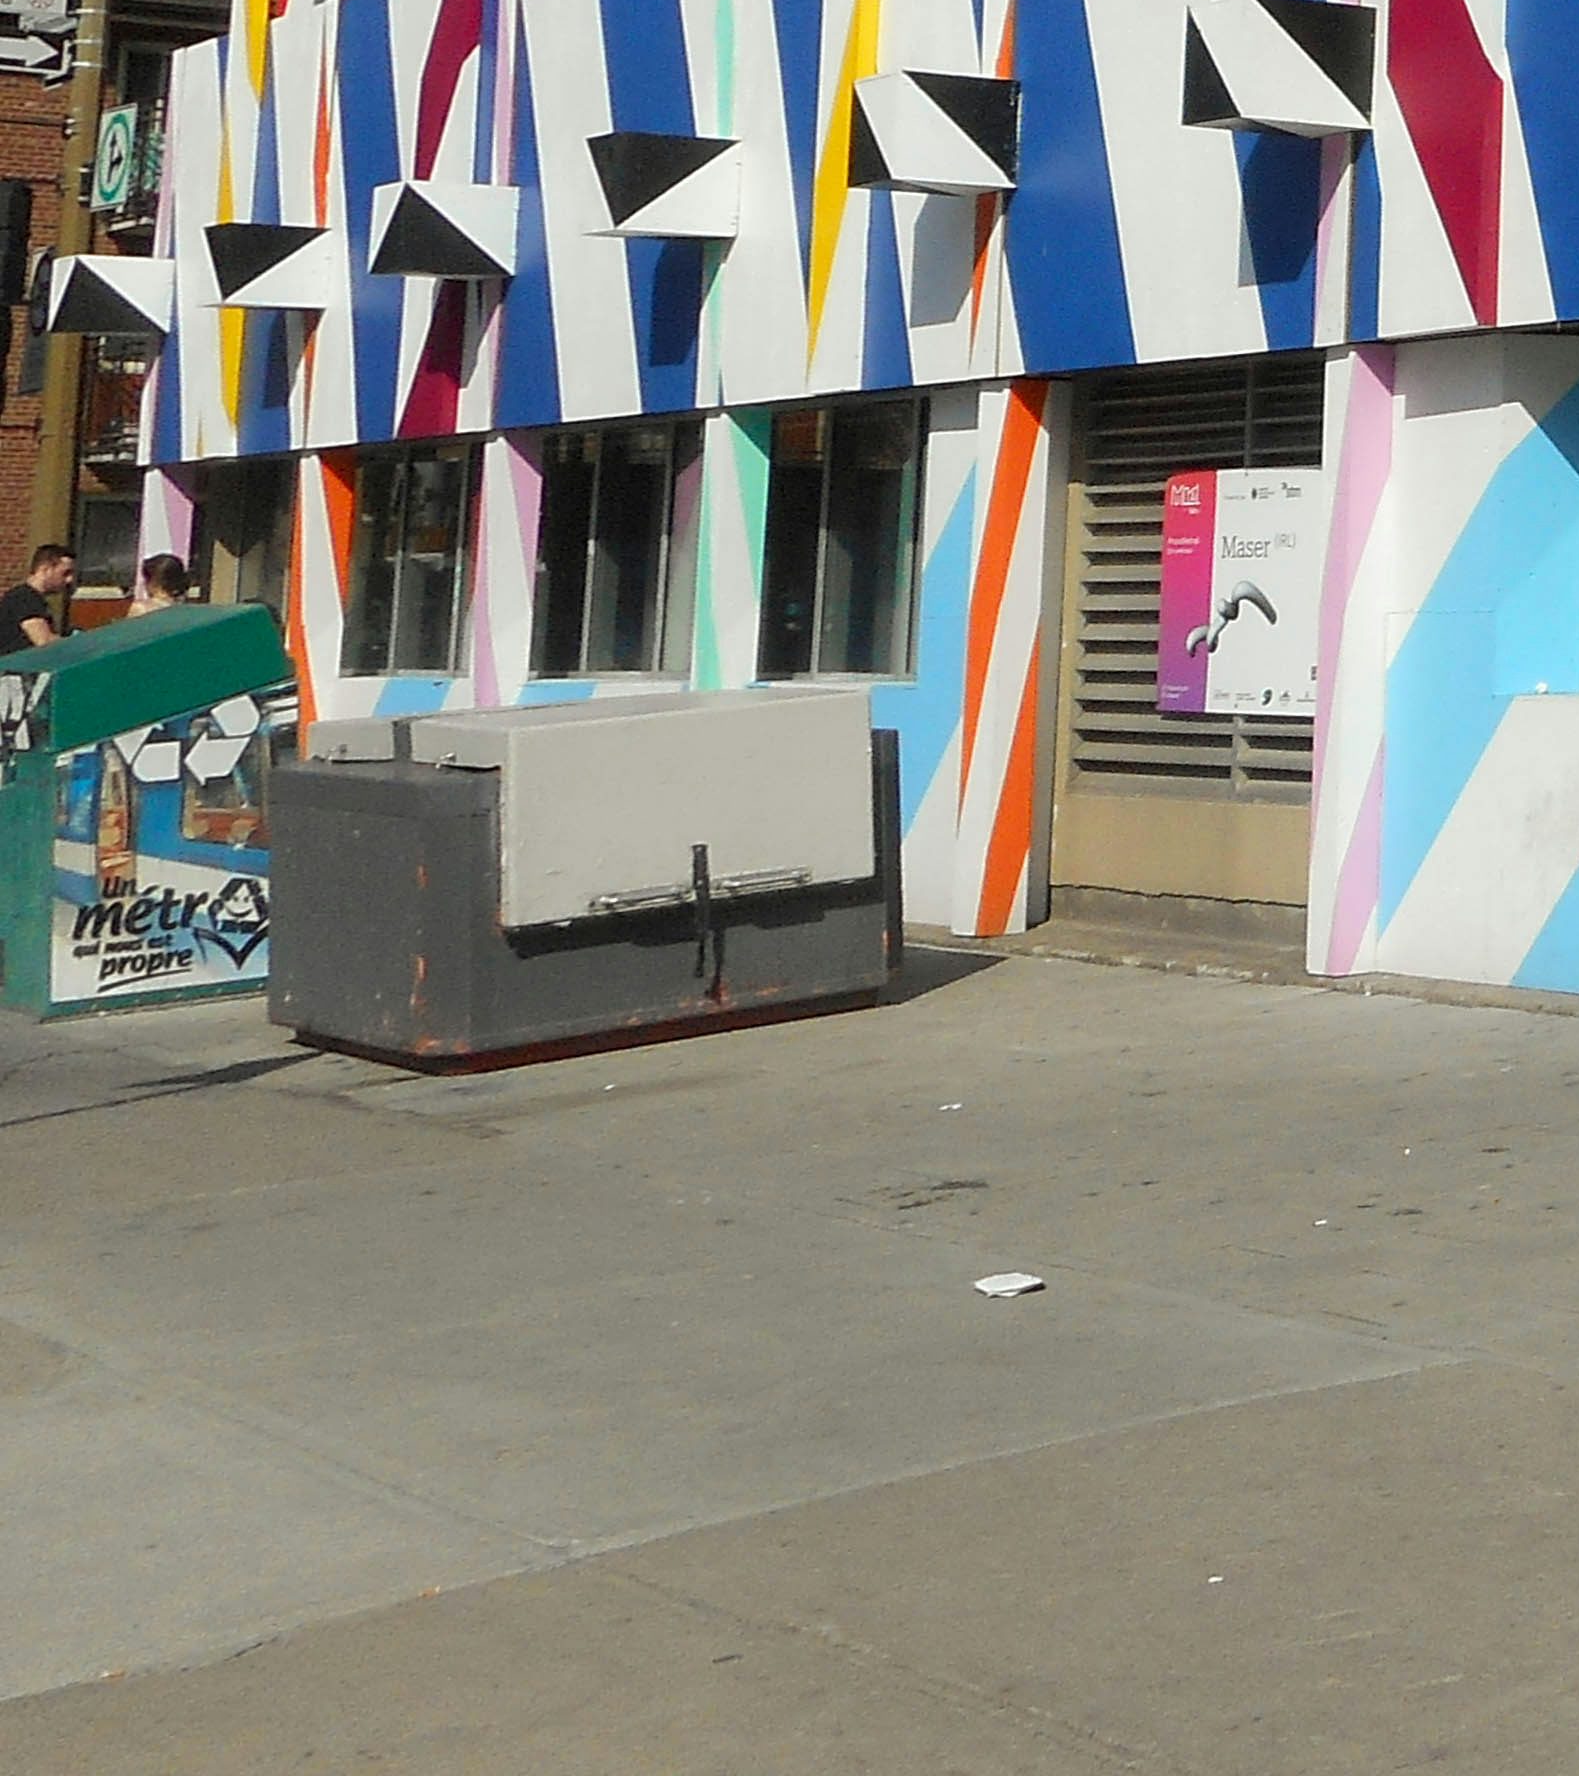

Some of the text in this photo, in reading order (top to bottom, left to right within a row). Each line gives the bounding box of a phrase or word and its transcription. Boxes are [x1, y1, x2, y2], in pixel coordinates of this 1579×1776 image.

[1220, 534, 1272, 559] Maser
[102, 876, 137, 899] un
[98, 947, 194, 981] propre
